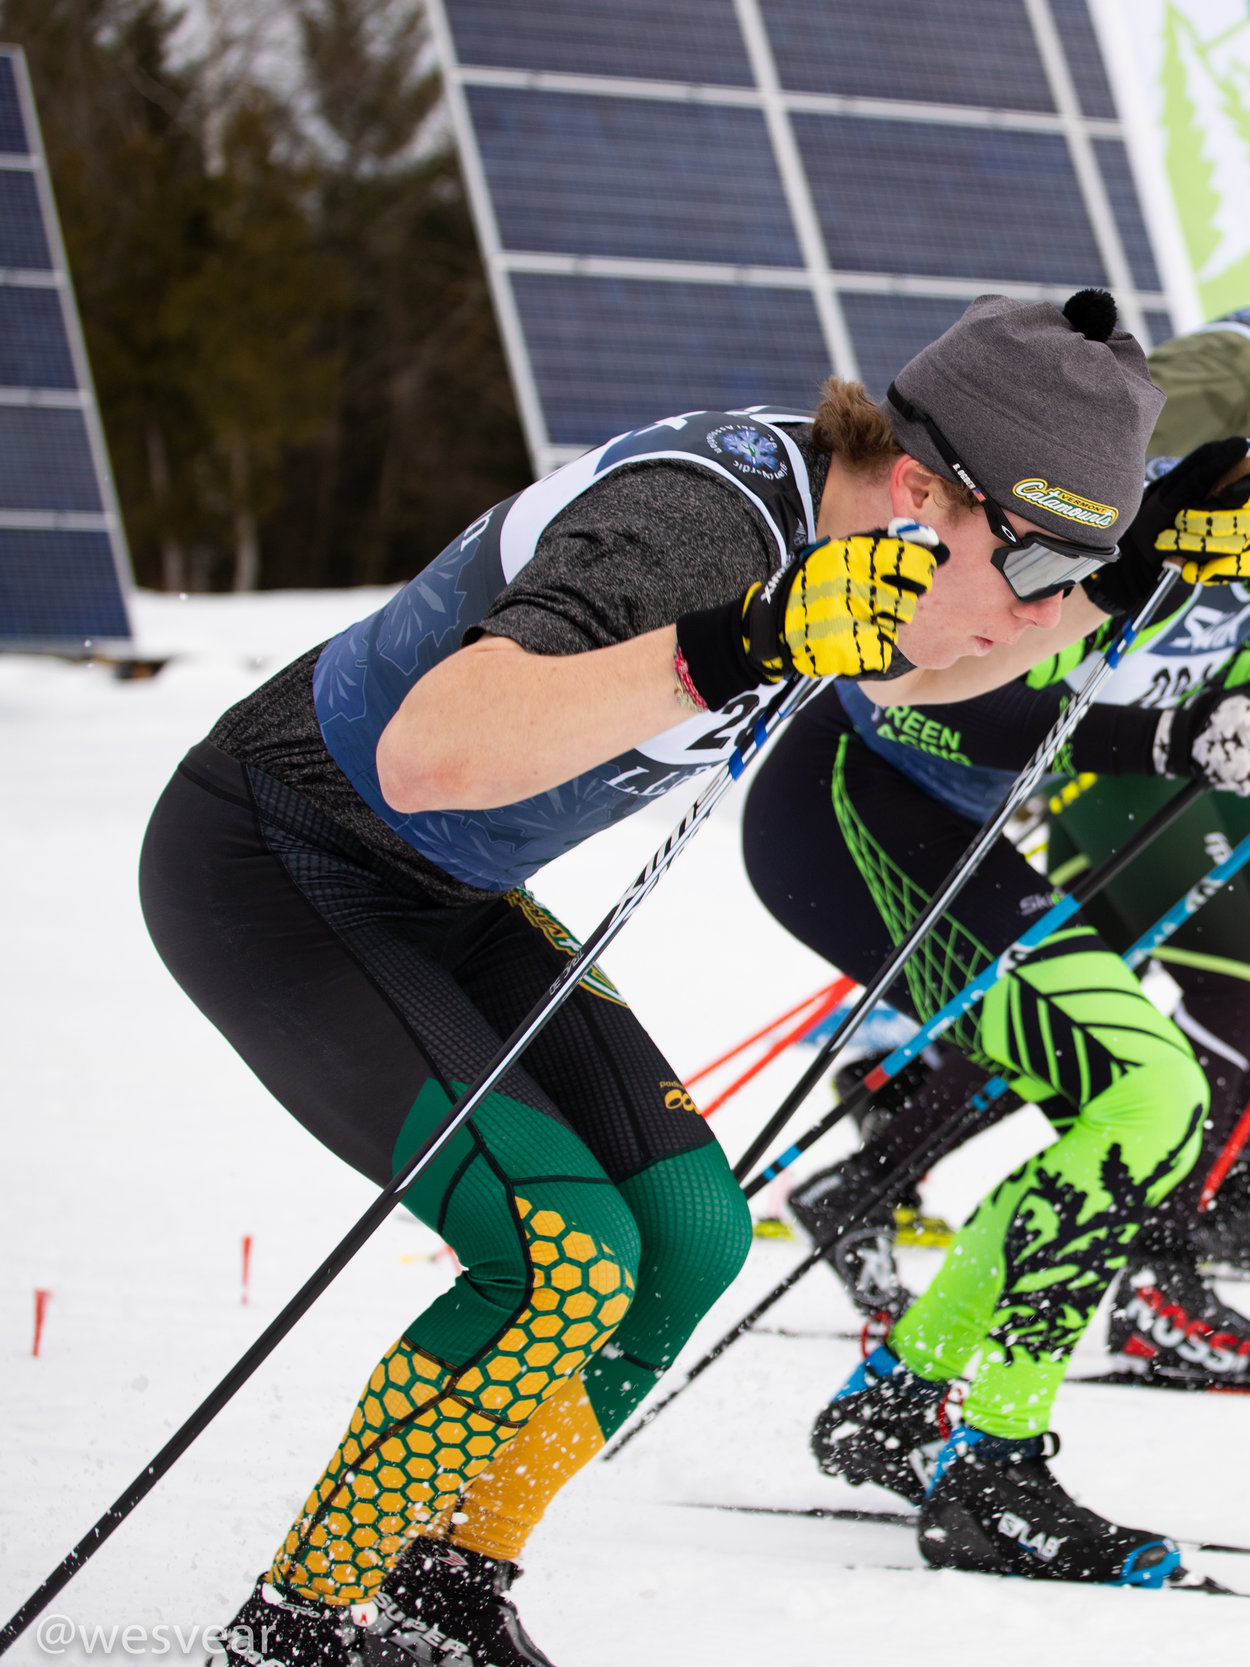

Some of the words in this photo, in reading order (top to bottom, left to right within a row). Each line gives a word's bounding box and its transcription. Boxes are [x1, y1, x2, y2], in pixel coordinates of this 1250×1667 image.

[1015, 481, 1112, 526] Catamounts
[1061, 493, 1106, 513] VERMONT
[884, 705, 962, 751] REEN
[372, 1591, 470, 1660] SUPER
